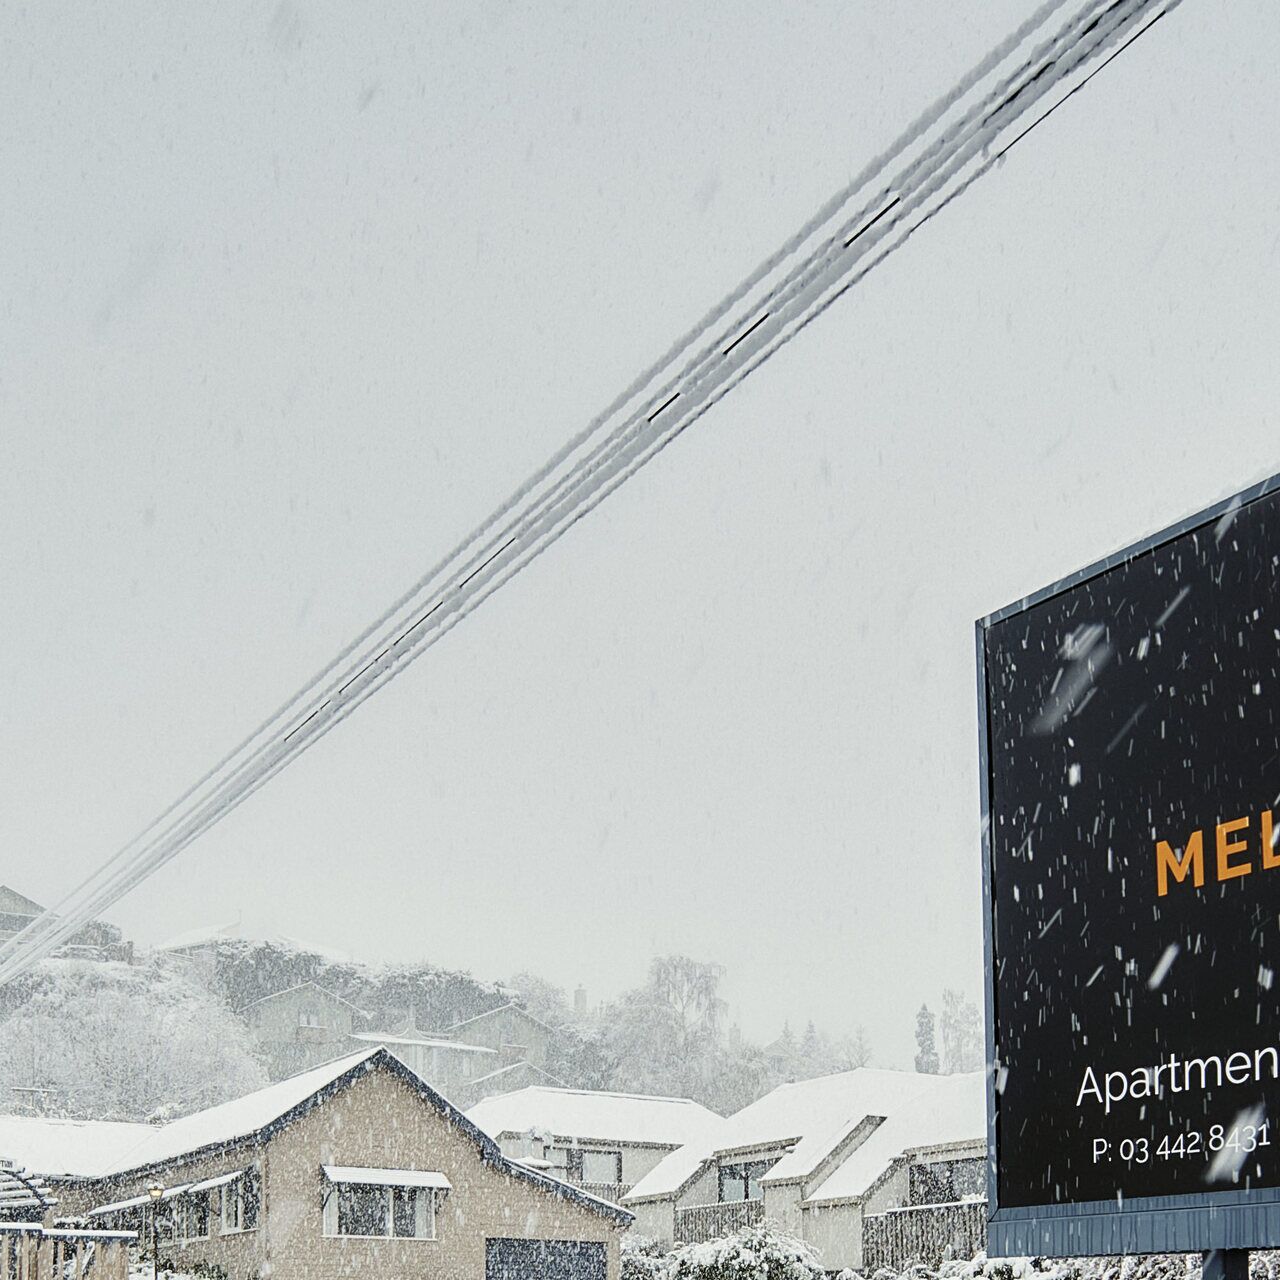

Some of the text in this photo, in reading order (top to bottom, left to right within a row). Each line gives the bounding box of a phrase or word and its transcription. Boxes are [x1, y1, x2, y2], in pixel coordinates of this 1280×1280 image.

[1092, 1137, 1113, 1164] P:
[1119, 1137, 1150, 1163] 03
[1156, 1131, 1202, 1159] 442
[1208, 1123, 1270, 1152] 8431
